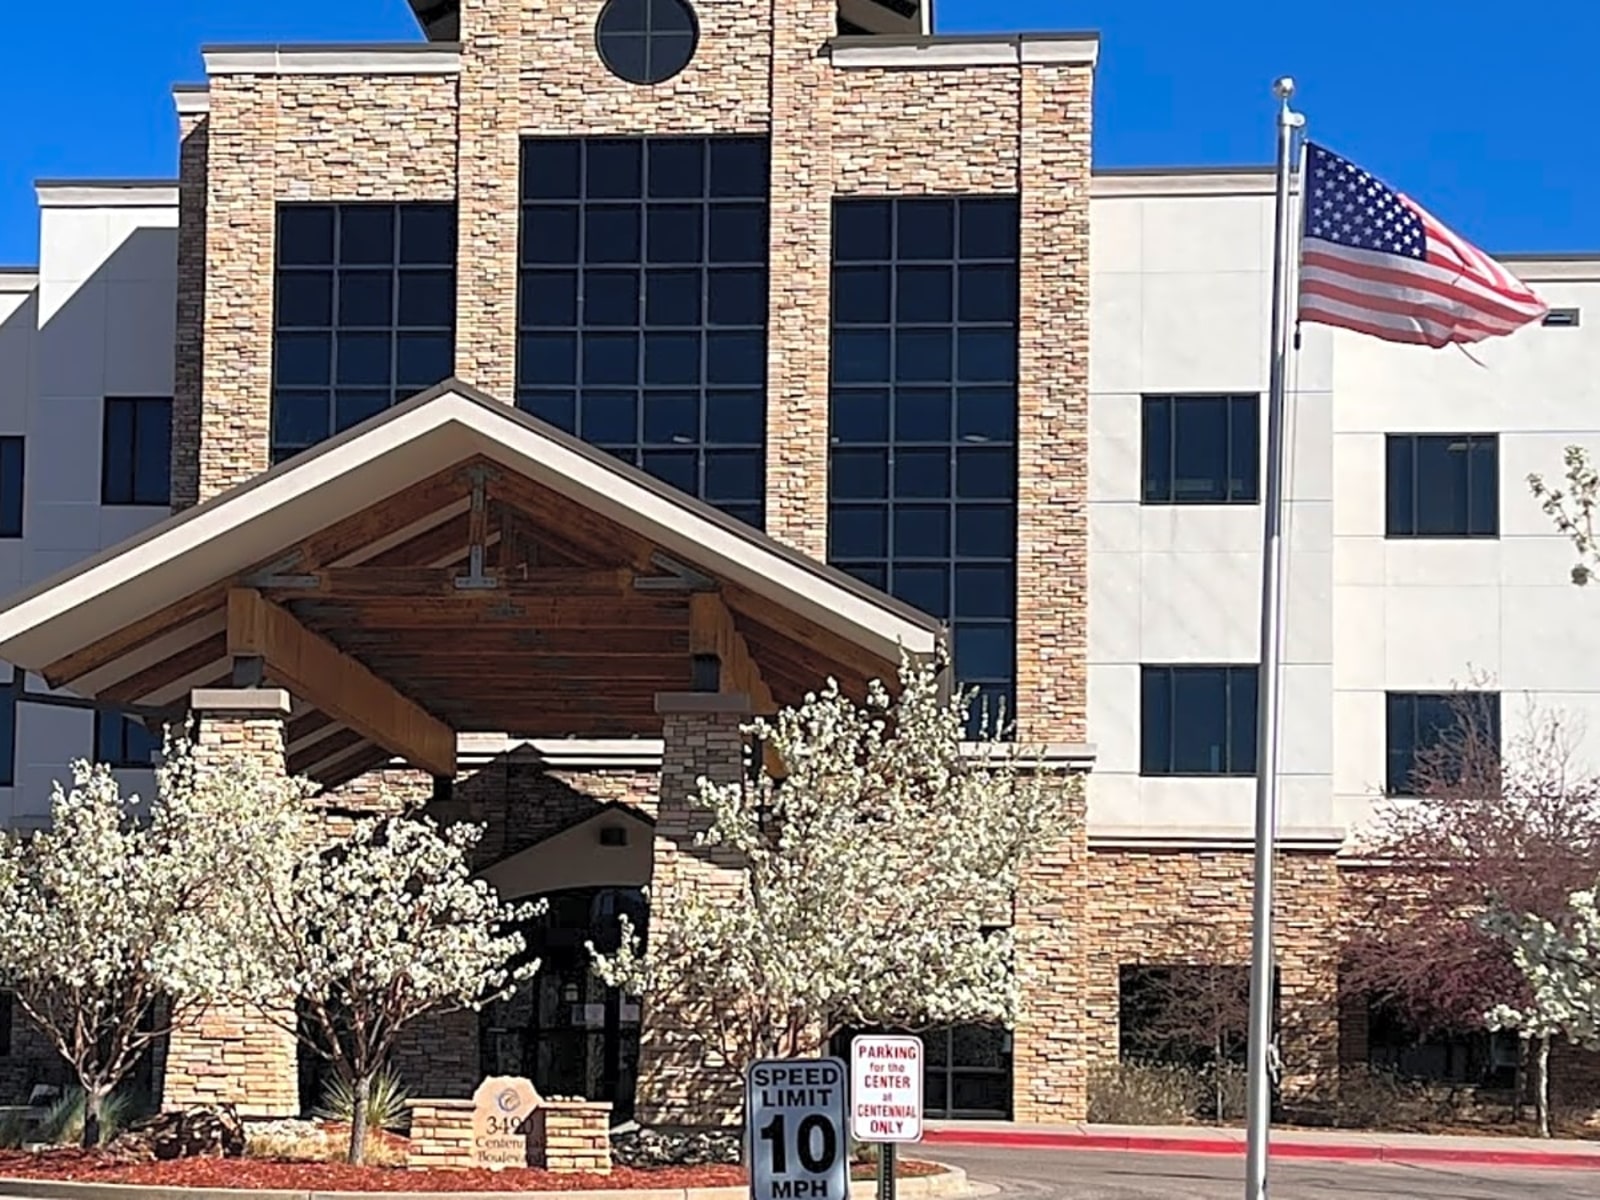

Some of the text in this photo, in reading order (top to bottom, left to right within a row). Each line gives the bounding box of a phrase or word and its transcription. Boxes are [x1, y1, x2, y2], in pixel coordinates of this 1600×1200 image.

[858, 1045, 917, 1060] PARKING
[870, 1062, 905, 1073] for the
[754, 1068, 839, 1086] SPEED
[864, 1075, 911, 1088] CENTER
[762, 1089, 833, 1107] LIMIT
[882, 1092, 893, 1102] at
[857, 1104, 917, 1118] CENTENNIAL
[486, 1115, 534, 1135] 3490
[870, 1120, 904, 1134] ONLY
[475, 1135, 544, 1150] Centennal
[760, 1113, 837, 1174] 10
[771, 1180, 828, 1199] MPH
